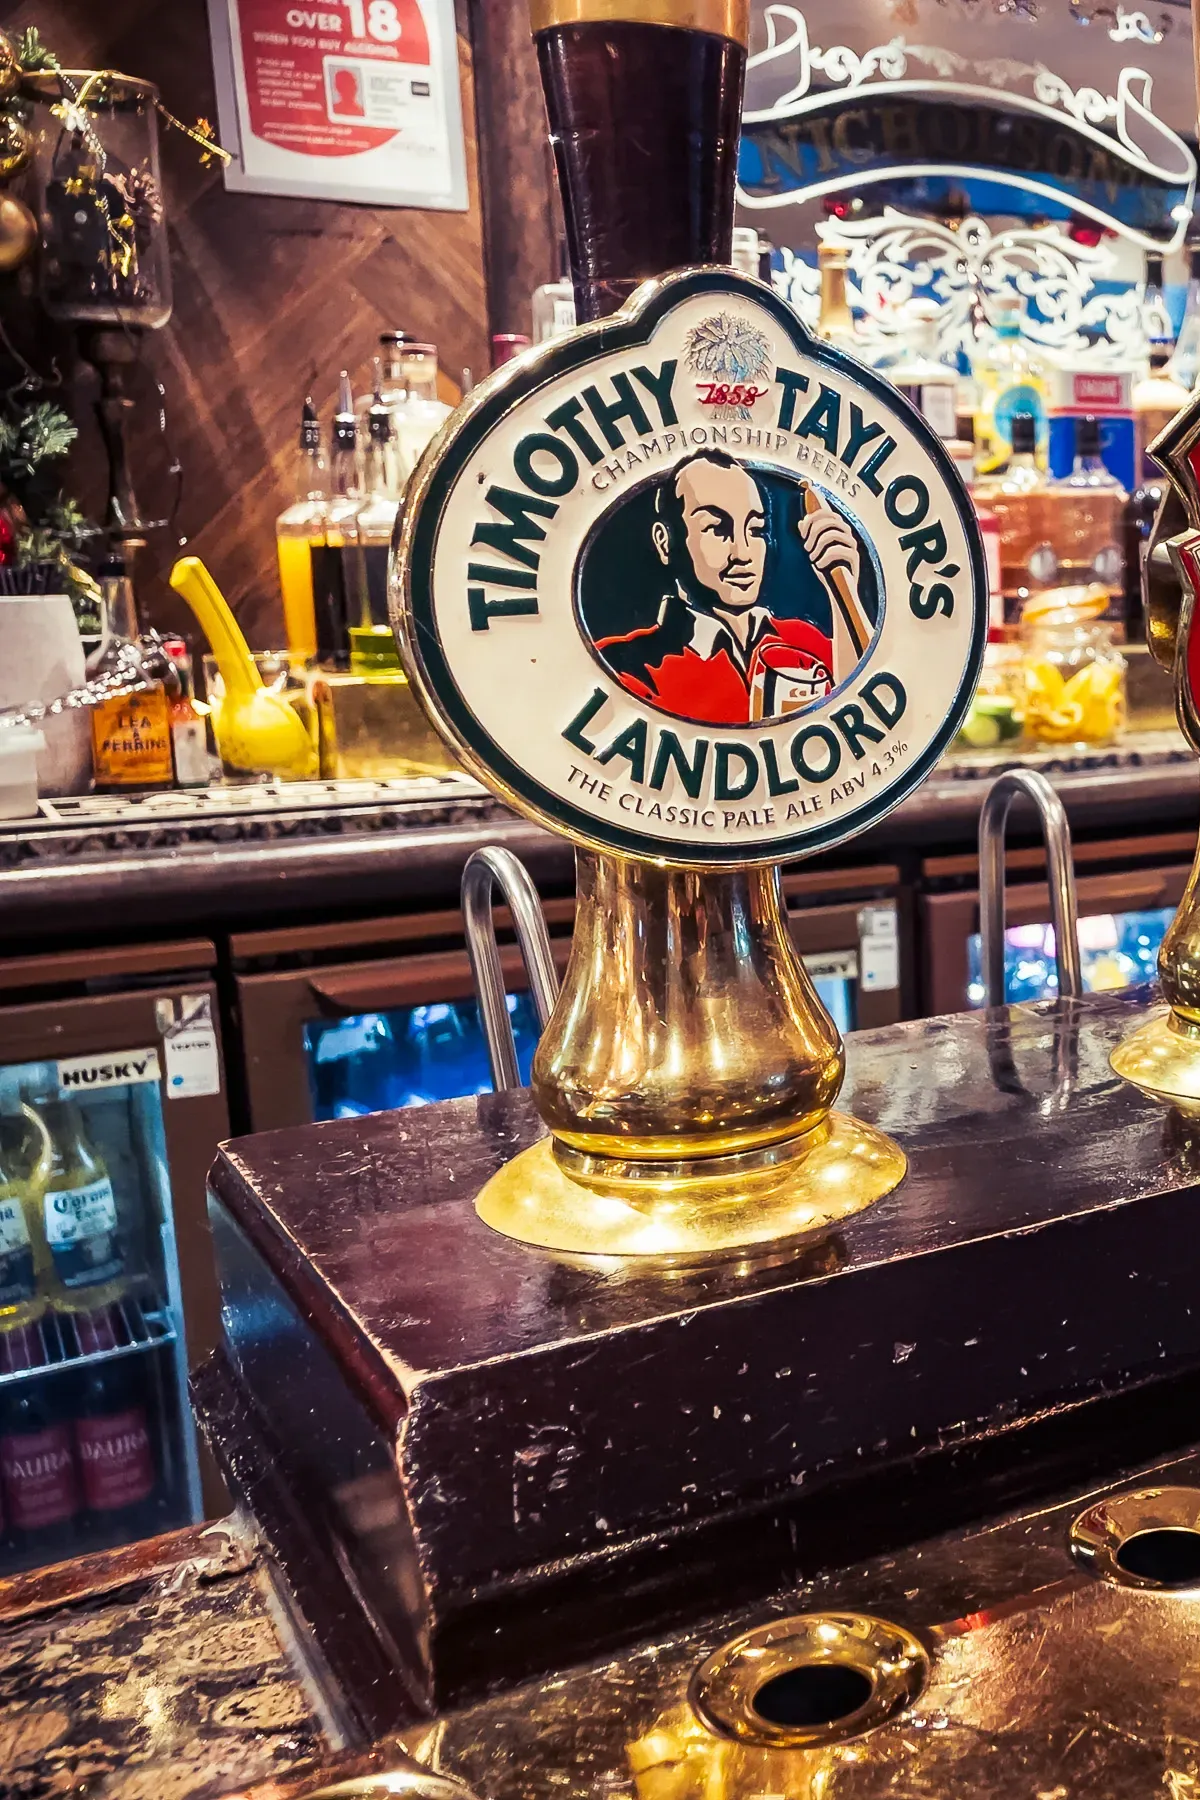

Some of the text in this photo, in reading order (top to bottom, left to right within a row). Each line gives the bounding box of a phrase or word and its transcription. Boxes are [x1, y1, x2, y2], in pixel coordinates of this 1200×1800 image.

[286, 0, 402, 43] OVER 18
[696, 382, 769, 407] 1858
[591, 425, 862, 499] CHAMPIONSHIP BEERS
[467, 358, 956, 633] TIMOTHY TAYLOR'S
[118, 715, 151, 729] LEA
[560, 671, 908, 802] LANDLORD
[567, 739, 910, 830] THE CLASSIC PALE ALE ABV 4.3%
[62, 1060, 148, 1086] HUSKY
[53, 1187, 110, 1214] Corona
